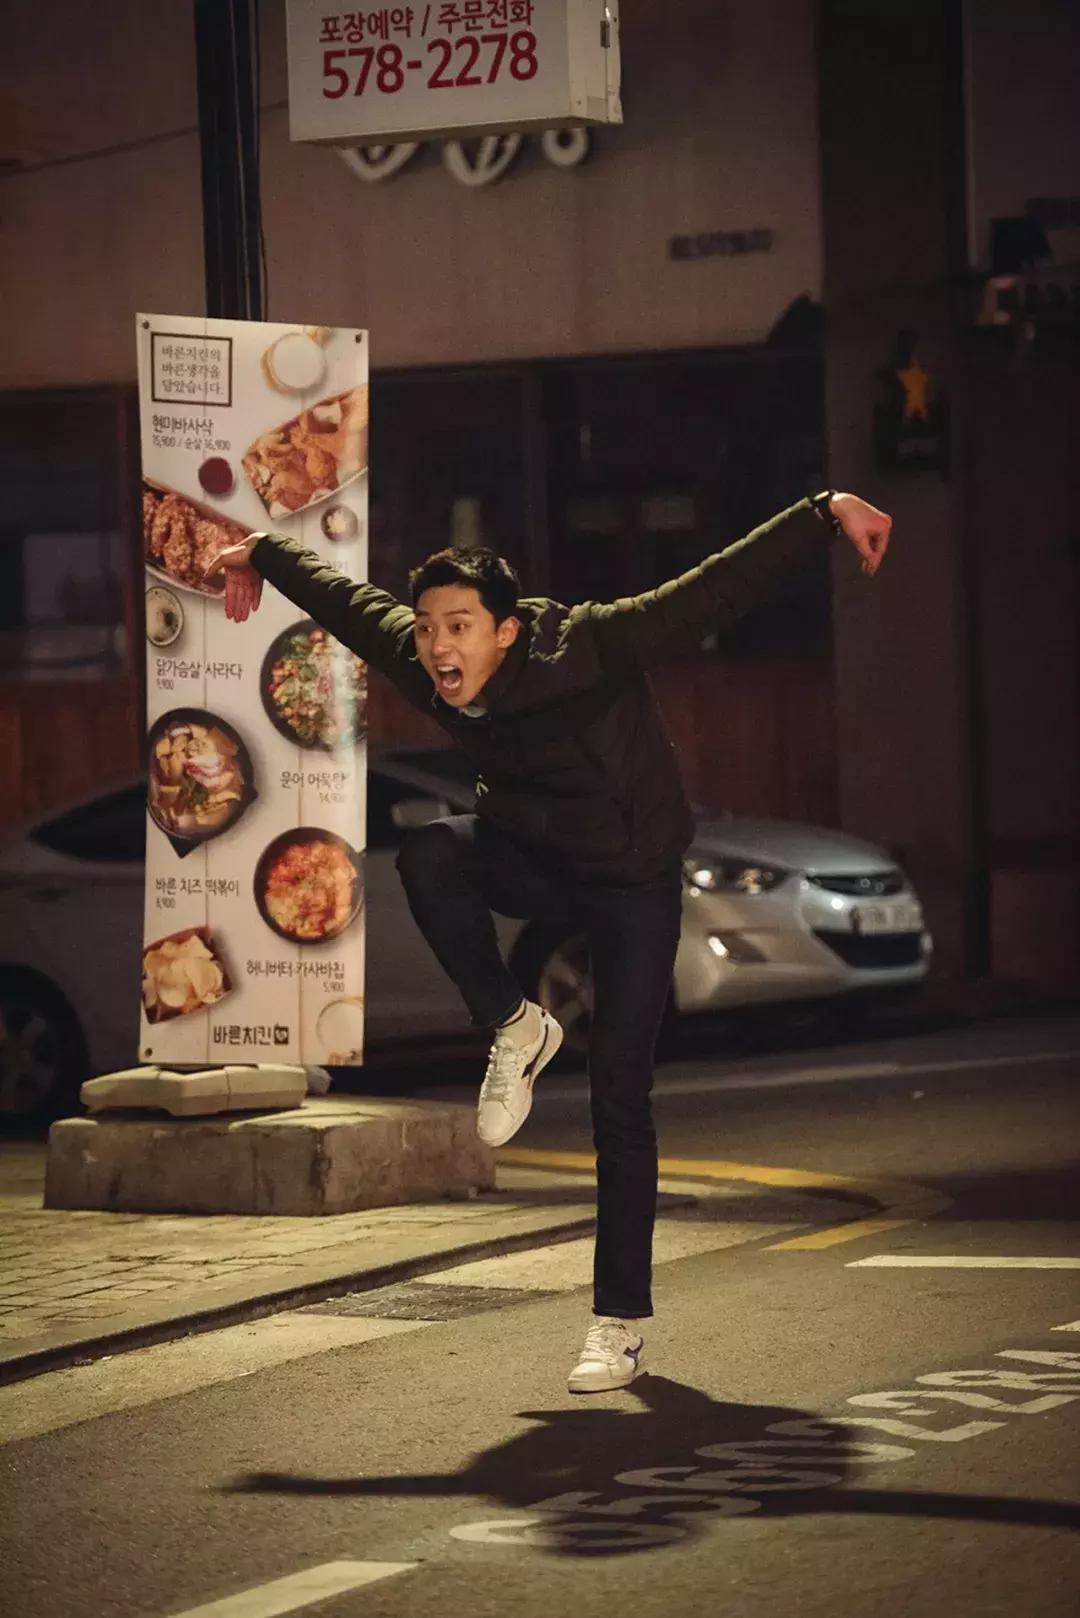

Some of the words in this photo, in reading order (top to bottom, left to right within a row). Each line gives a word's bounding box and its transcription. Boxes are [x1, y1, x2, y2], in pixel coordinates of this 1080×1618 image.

[319, 8, 414, 44] 포장예약
[420, 5, 431, 37] /
[437, 0, 535, 34] 주문전화
[322, 30, 539, 100] 578-2278
[152, 414, 214, 436] 현미바사삭
[156, 658, 201, 680] 닭가슴살
[204, 662, 244, 681] 사라다
[279, 771, 305, 790] 문어
[156, 877, 178, 897] 바른
[180, 878, 203, 895] 치즈
[205, 879, 240, 898] 떡볶이
[246, 959, 294, 980] 허니버터
[295, 960, 346, 981] 카사바칩
[213, 1024, 272, 1046] 바른치킨
